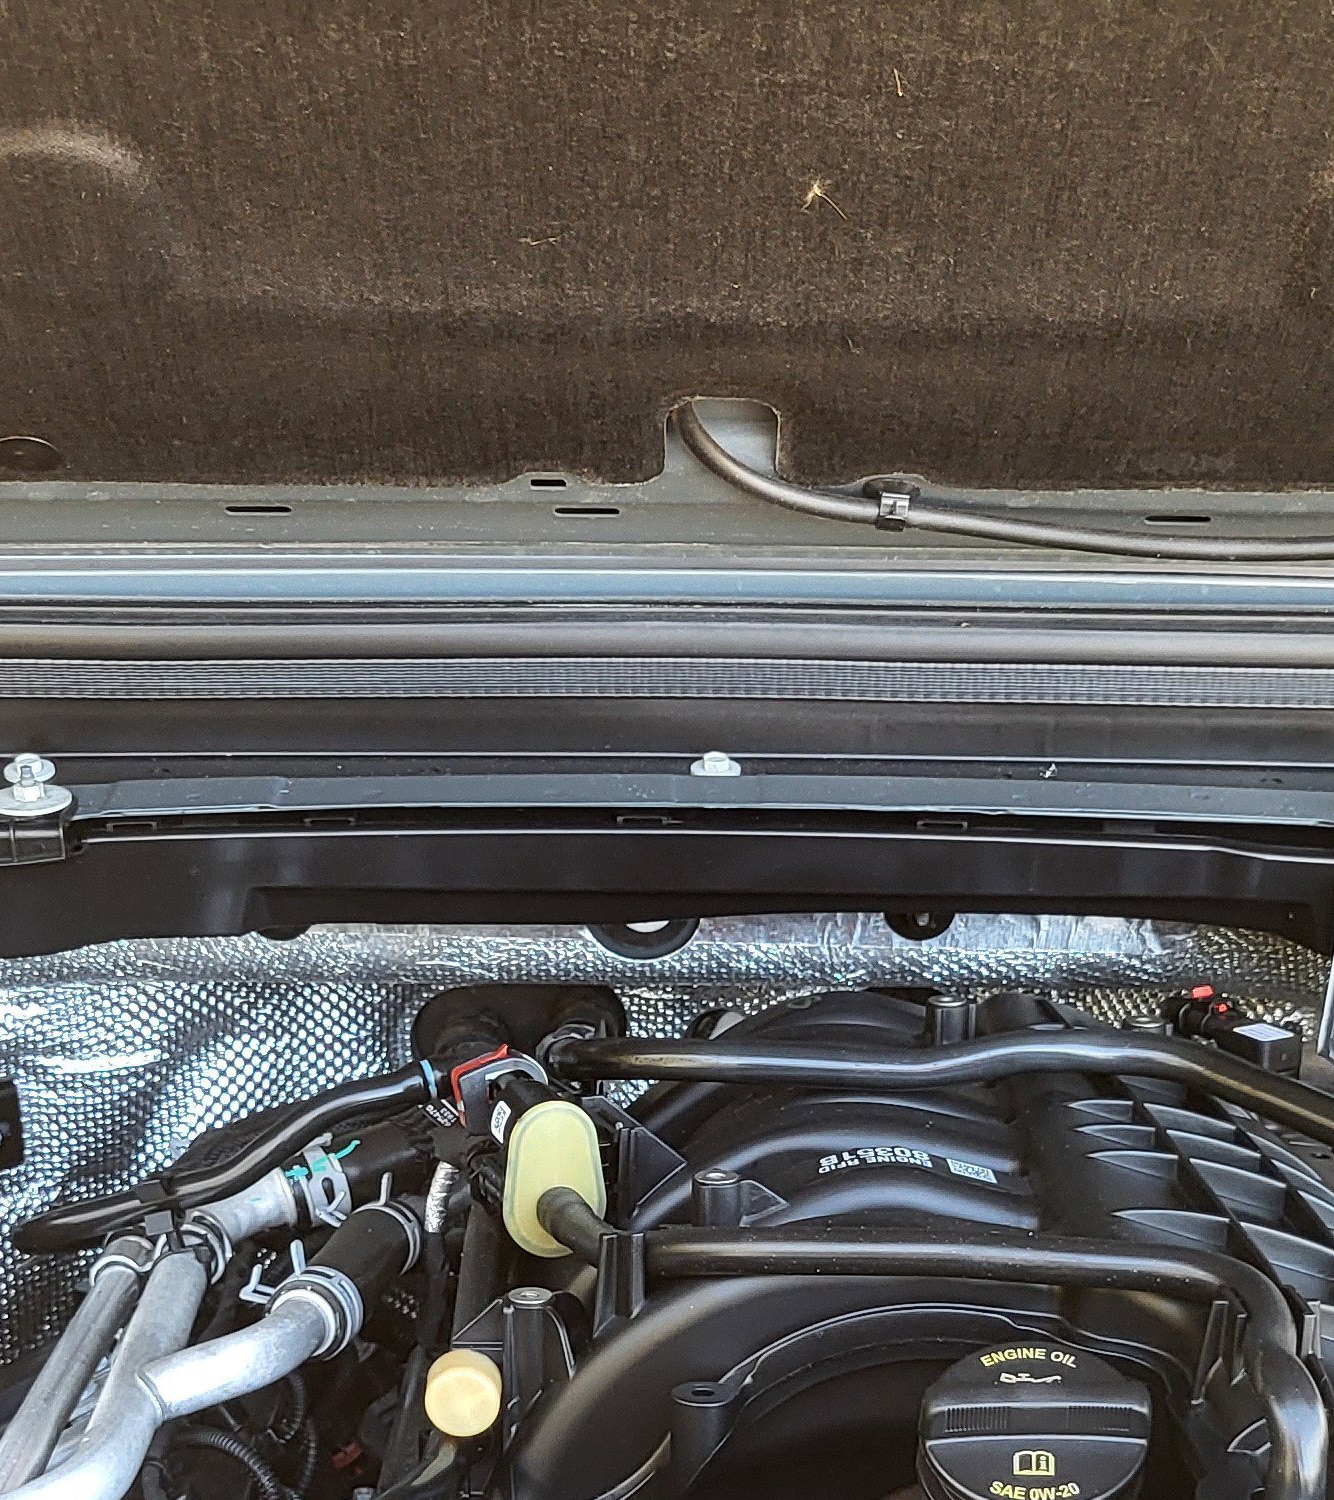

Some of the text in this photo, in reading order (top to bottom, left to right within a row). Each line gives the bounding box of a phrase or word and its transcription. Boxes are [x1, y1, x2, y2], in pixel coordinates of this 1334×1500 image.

[818, 1155, 933, 1174] ENGINE RFID
[819, 1146, 930, 1166] 80351B
[979, 1347, 1077, 1368] ENGINE OIL
[989, 1481, 1080, 1500] SAE 0W-20
